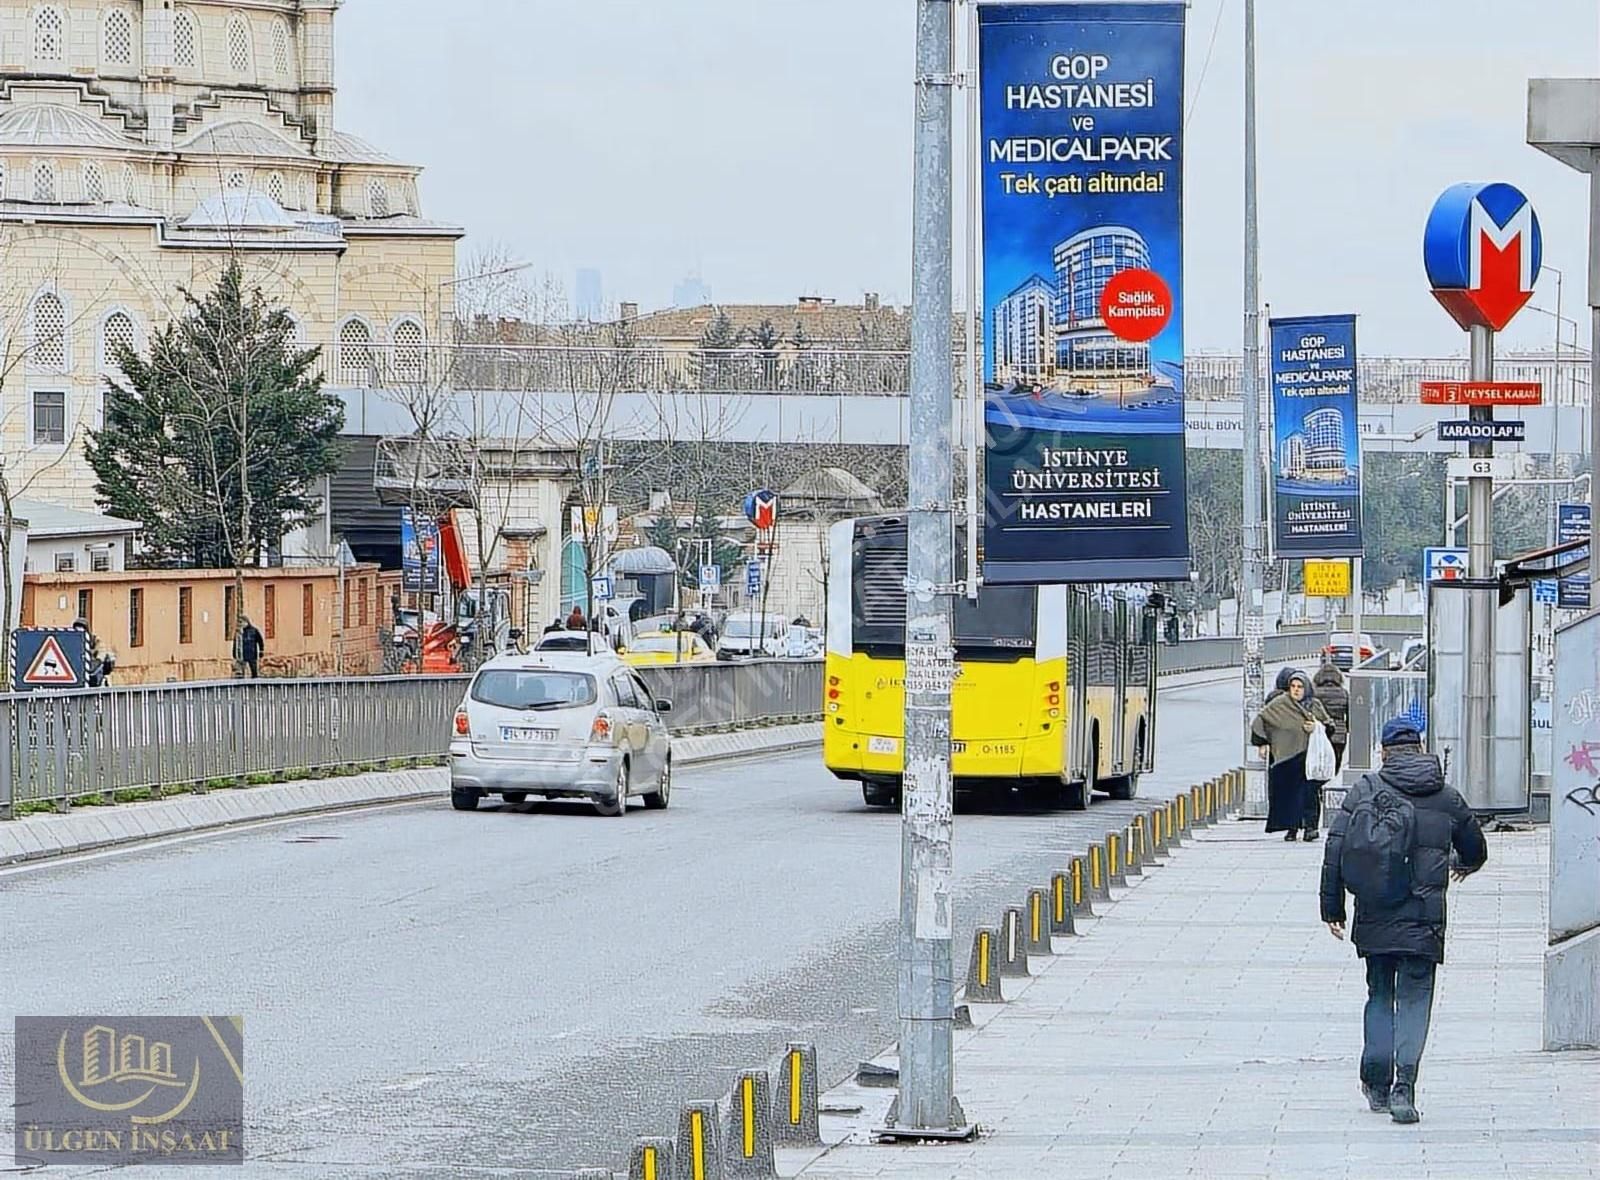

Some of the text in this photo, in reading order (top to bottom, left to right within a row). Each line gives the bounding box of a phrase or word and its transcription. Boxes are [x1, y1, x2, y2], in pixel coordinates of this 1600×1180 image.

[1052, 55, 1108, 80] GOP
[1006, 79, 1153, 109] HASTANESİ
[1072, 116, 1094, 131] ve
[990, 137, 1172, 162] MEDICALPARK
[1000, 172, 1164, 198] Tek çatı altında!
[1118, 292, 1155, 306] Sağlık
[1108, 305, 1165, 318] Kampüsü
[1301, 336, 1326, 348] GOP
[1282, 345, 1345, 362] HASTANESİ
[1275, 369, 1353, 384] MEDICALPARK
[1281, 387, 1298, 397] Tek
[1464, 389, 1503, 399] VEYSEL
[1442, 425, 1513, 437] KARADOLAP
[1043, 447, 1128, 467] İSTİNYE
[1473, 462, 1492, 474] G3
[1013, 468, 1160, 489] ÜNİVERSİTESİ
[1021, 499, 1151, 519] HASTANELERİ
